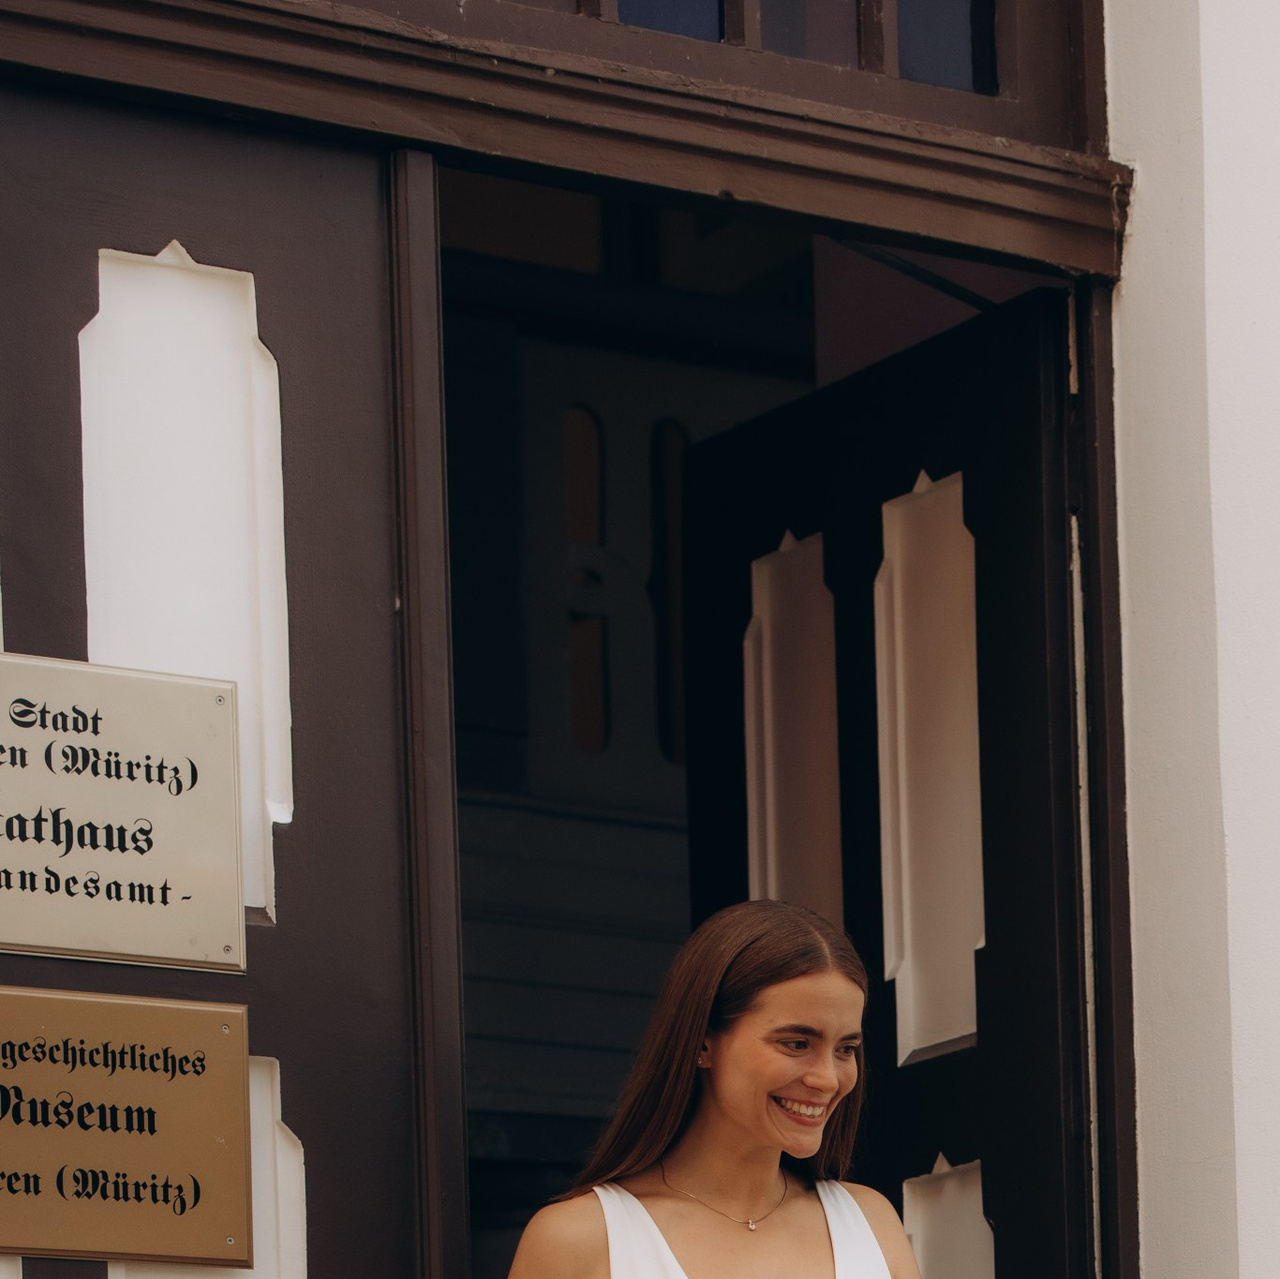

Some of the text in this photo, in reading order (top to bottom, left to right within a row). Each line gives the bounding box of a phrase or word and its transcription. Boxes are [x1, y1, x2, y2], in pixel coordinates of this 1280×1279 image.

[9, 697, 103, 737] Stadt
[44, 740, 199, 797] (Müritz)
[0, 804, 154, 859] athaus
[1, 1036, 206, 1082] geschichtliches
[55, 1164, 201, 1216] (Müritz)
